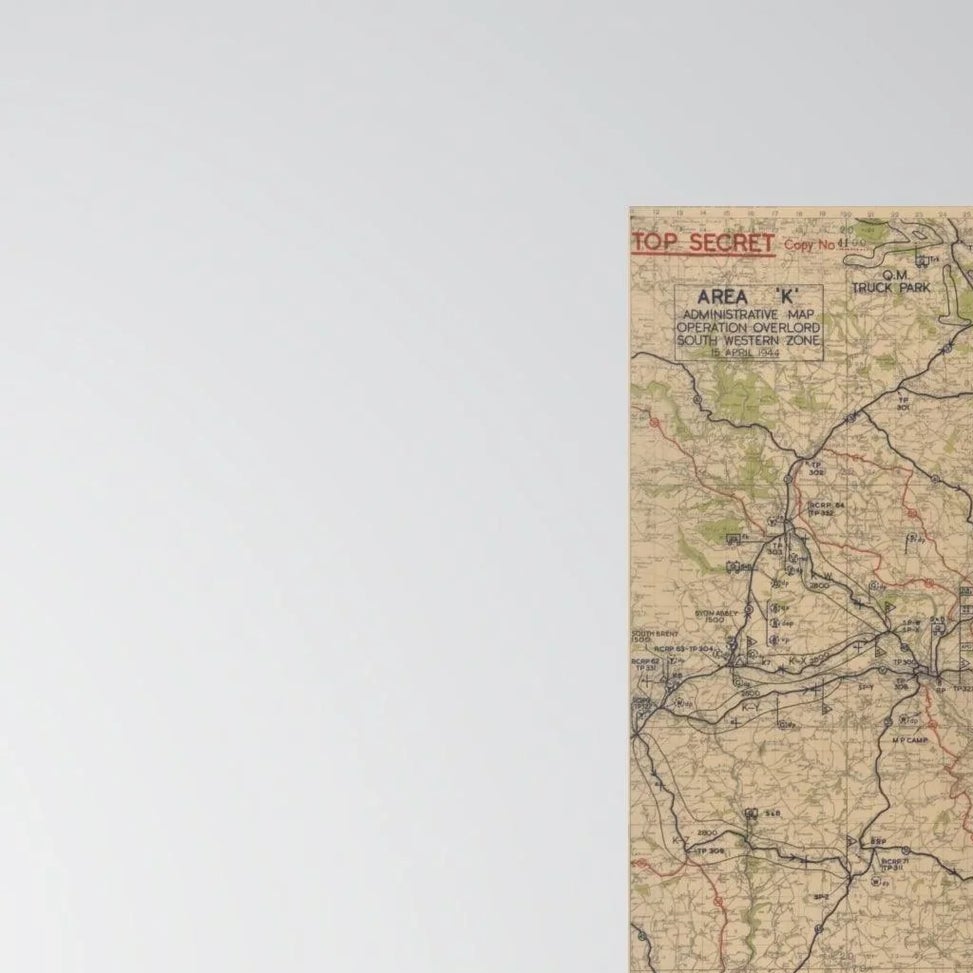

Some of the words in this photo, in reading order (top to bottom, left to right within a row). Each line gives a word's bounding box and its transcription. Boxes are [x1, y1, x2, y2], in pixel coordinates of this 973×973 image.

[631, 232, 678, 253] TOP
[690, 232, 776, 253] SECRET
[784, 239, 813, 251] Copy
[819, 239, 835, 250] No
[852, 282, 892, 293] TRUCK
[900, 282, 931, 293] PARK
[698, 289, 748, 304] AREA
[683, 310, 778, 319] ADMINISTRATIVE
[788, 310, 814, 319] MAP
[677, 322, 747, 333] OPERATION
[753, 322, 820, 333] OVERLORD
[677, 335, 718, 346] SOUTH
[725, 335, 778, 346] WESTERN
[786, 335, 820, 346] ZONE
[725, 348, 752, 357] APRIL
[759, 348, 780, 357] 1944
